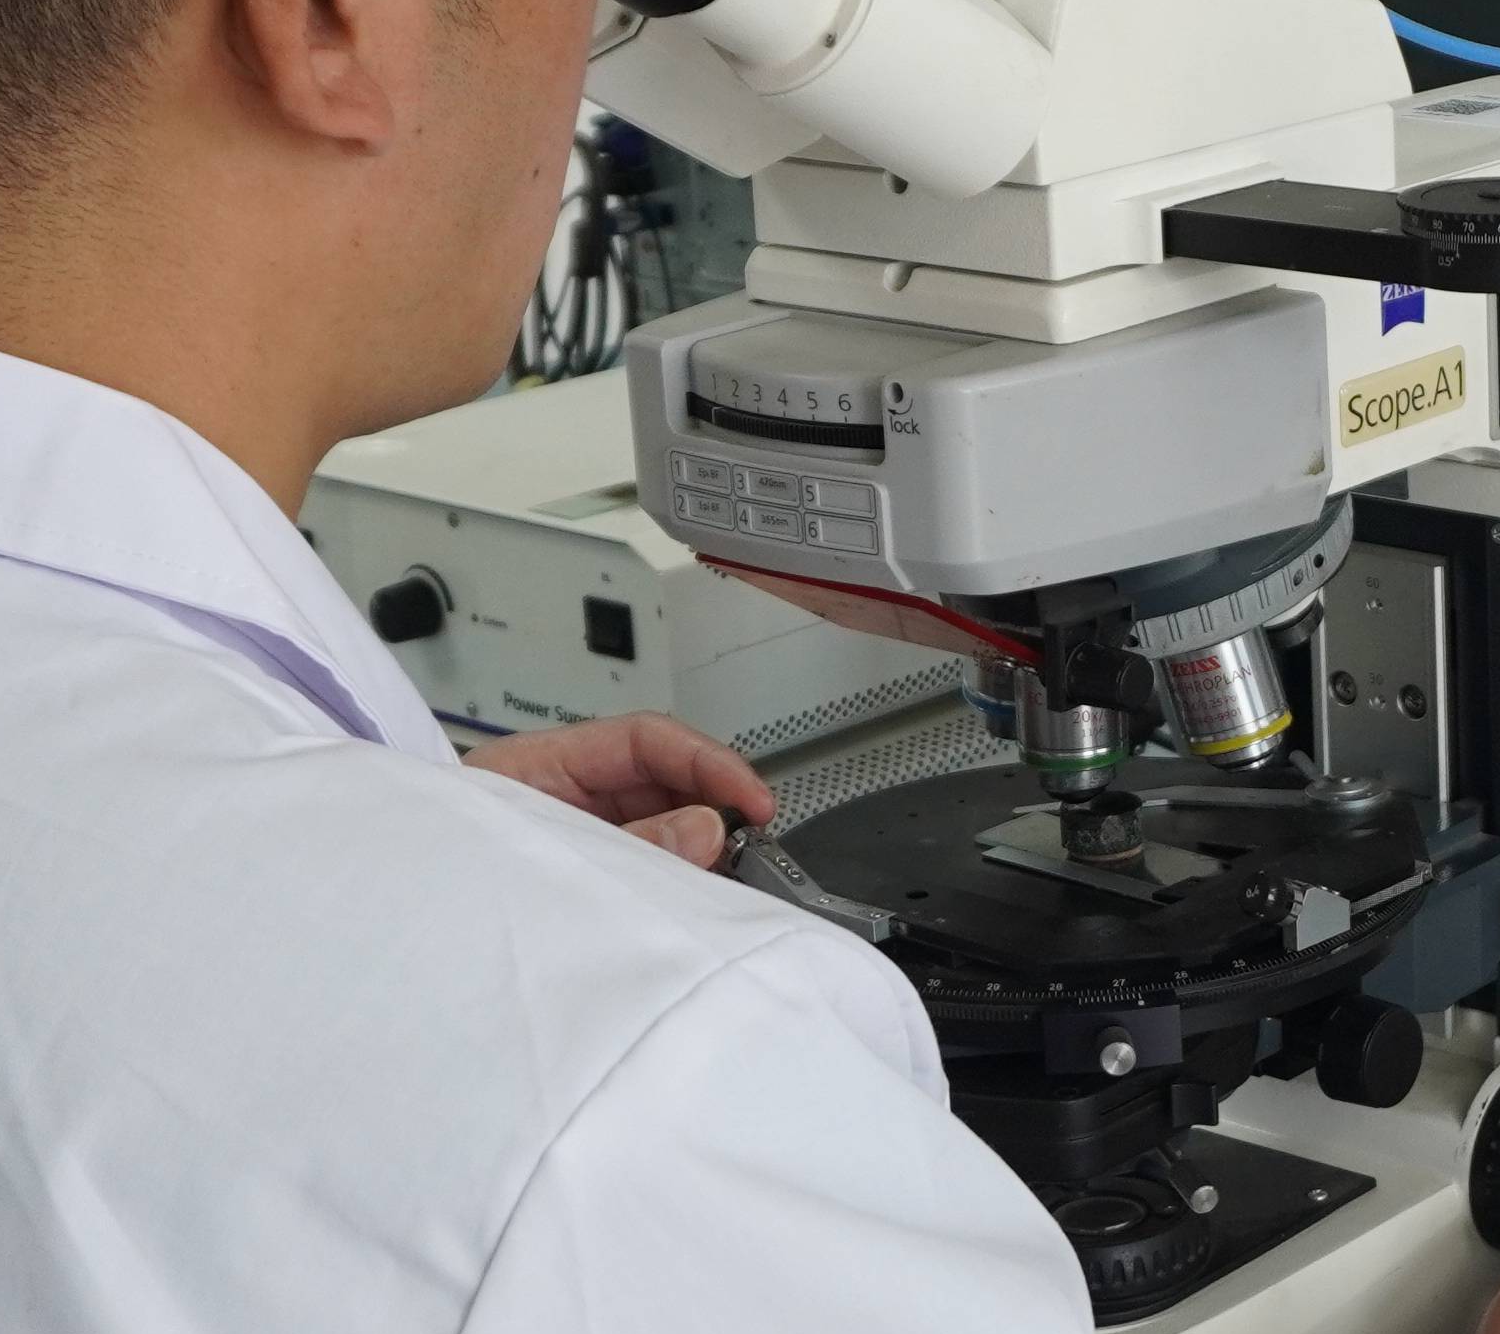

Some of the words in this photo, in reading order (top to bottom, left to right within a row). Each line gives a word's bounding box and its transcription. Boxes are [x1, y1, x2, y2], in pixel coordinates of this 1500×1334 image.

[1463, 221, 1475, 233] 70
[1383, 283, 1425, 301] ZEI
[731, 379, 741, 398] 2
[752, 383, 762, 401] 3
[777, 388, 789, 406] 4
[806, 391, 818, 409] 5
[838, 394, 852, 412] 6
[1348, 360, 1463, 433] Scope.A1
[890, 415, 920, 435] lock
[674, 460, 682, 476] 1
[736, 473, 746, 490] 3
[805, 485, 816, 502] 5
[677, 495, 686, 513] 2
[739, 508, 749, 526] 4
[808, 521, 818, 539] 6
[1177, 665, 1252, 694] HROPLAN
[504, 690, 550, 718] Power
